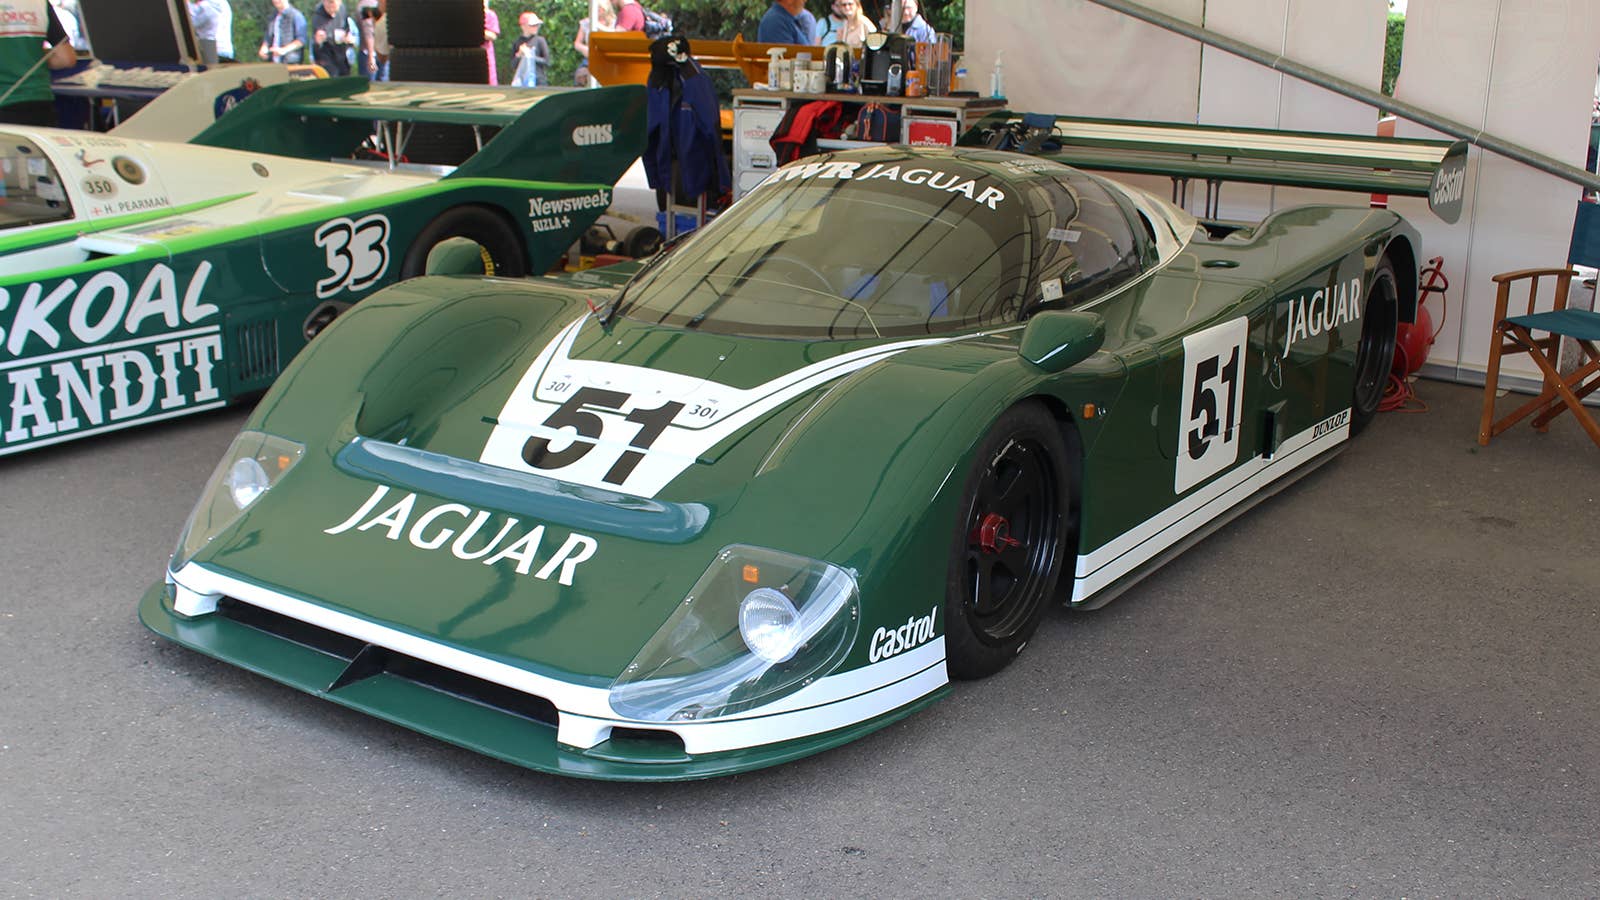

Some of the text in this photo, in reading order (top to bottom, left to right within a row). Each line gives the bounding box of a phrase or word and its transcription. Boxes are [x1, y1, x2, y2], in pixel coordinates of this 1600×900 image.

[85, 180, 112, 194] 350
[118, 196, 170, 211] PEARMAN
[528, 189, 609, 217] Newsweek
[856, 164, 1005, 210] JAGUAR
[1434, 166, 1465, 204] Castrol
[314, 213, 391, 298] 33
[0, 260, 219, 356] KOAL
[1282, 278, 1361, 359] JAGUAR
[0, 334, 223, 443] ANDIT
[1188, 345, 1240, 460] 51
[521, 386, 686, 486] 51
[1312, 411, 1348, 439] DUNLOP
[323, 485, 598, 586] JAGUAR
[868, 606, 938, 663] Castrol
